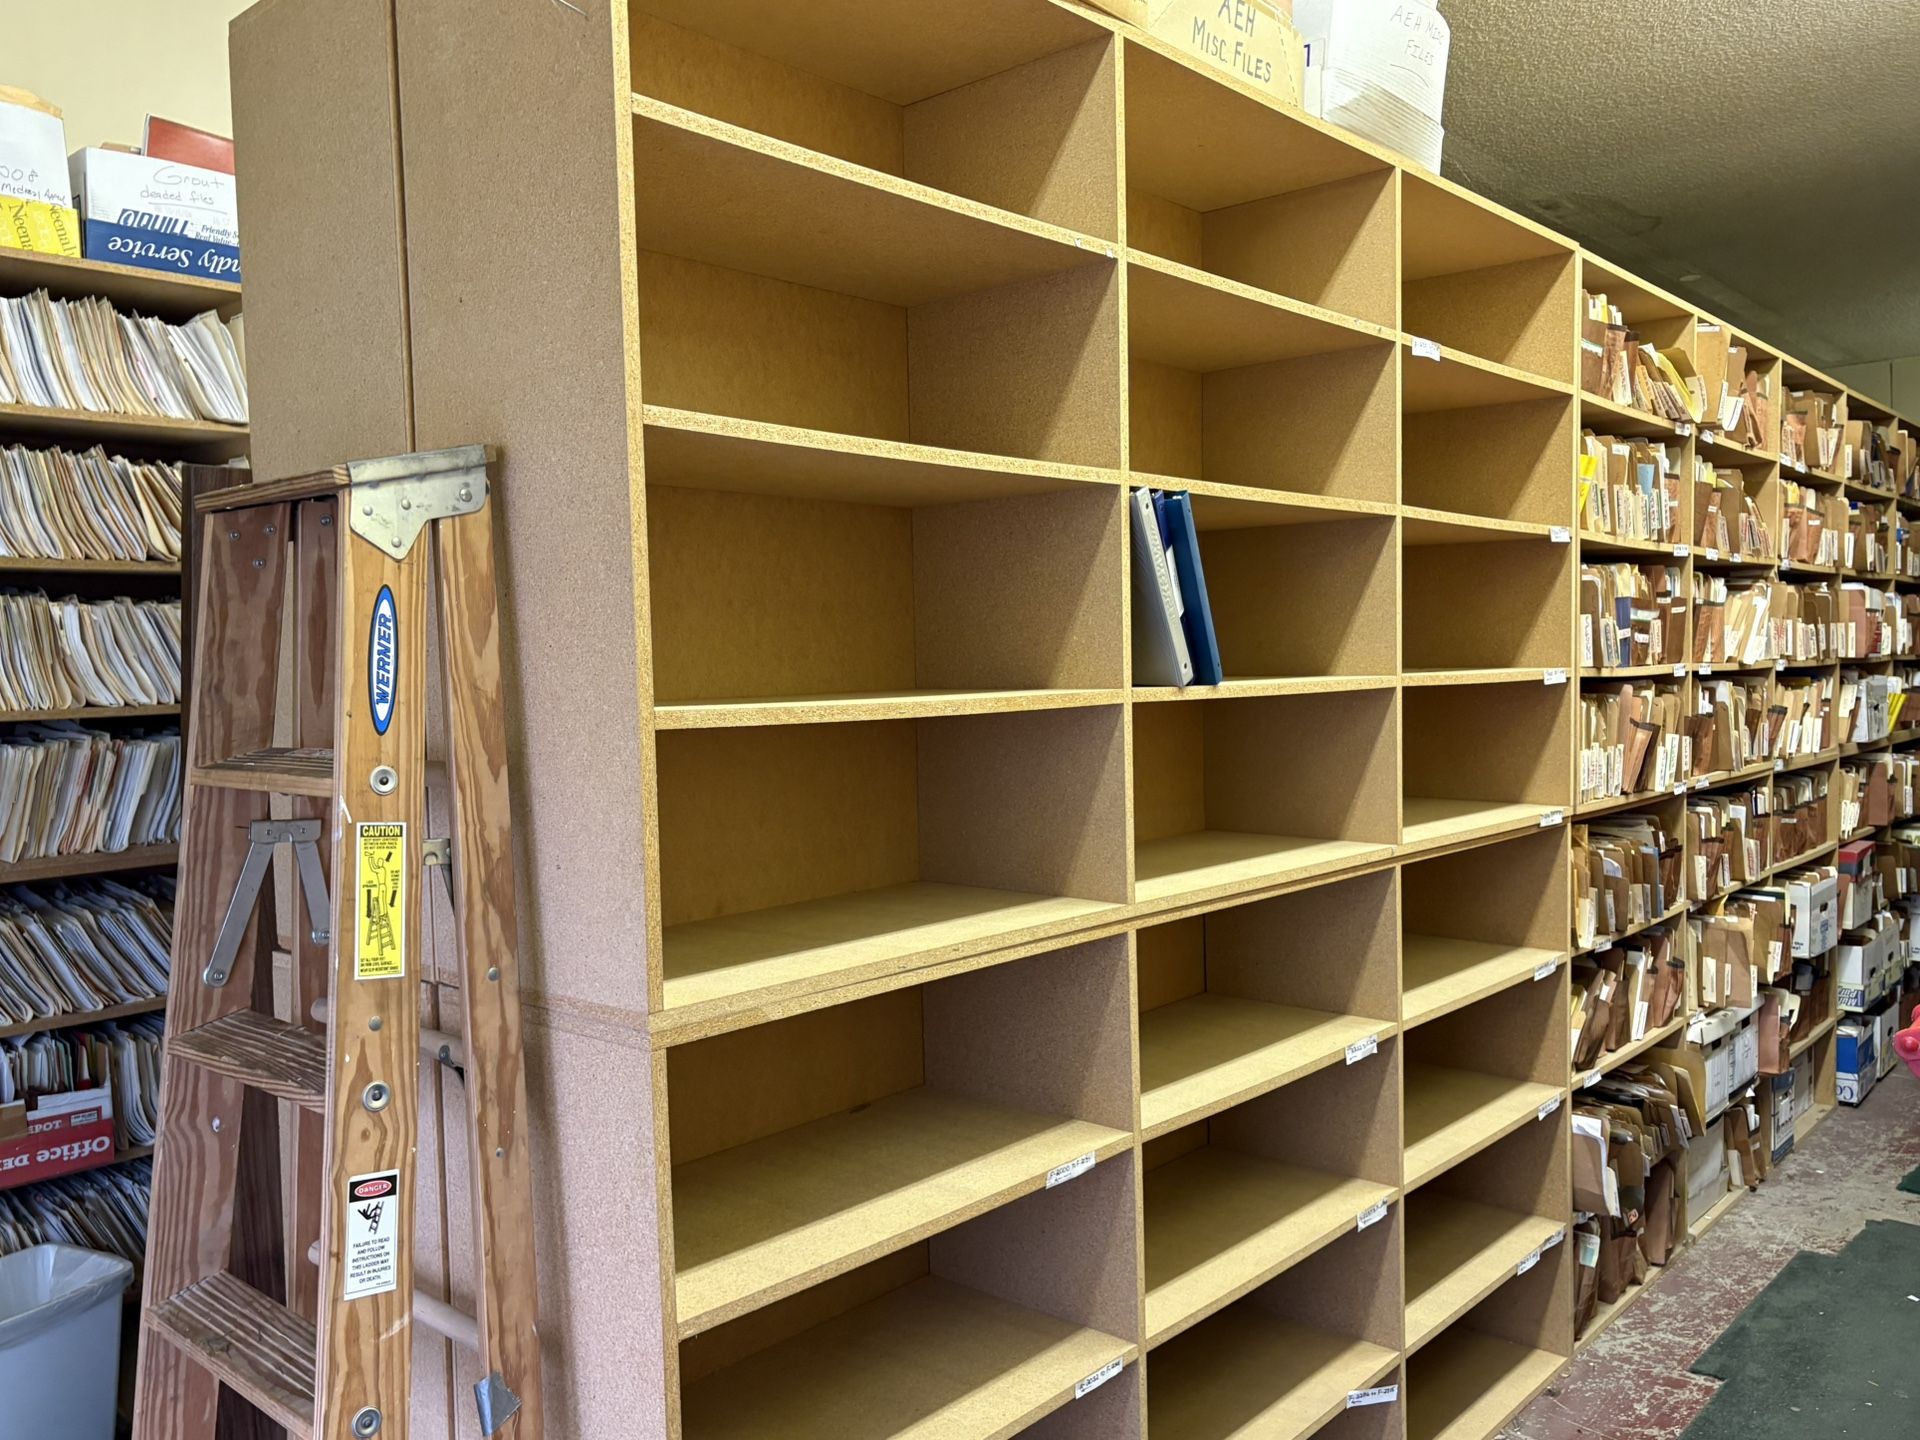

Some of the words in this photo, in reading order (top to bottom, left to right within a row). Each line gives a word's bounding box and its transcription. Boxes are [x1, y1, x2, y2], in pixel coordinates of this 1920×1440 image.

[1217, 0, 1256, 37] AEH
[1390, 5, 1422, 31] AEH
[1233, 41, 1272, 84] FILES
[1404, 39, 1435, 66] FILES
[108, 236, 193, 268] Service
[375, 613, 392, 705] WERNER
[362, 825, 400, 837] CAUTION
[36, 1136, 111, 1162] Office
[0, 1154, 30, 1172] DE
